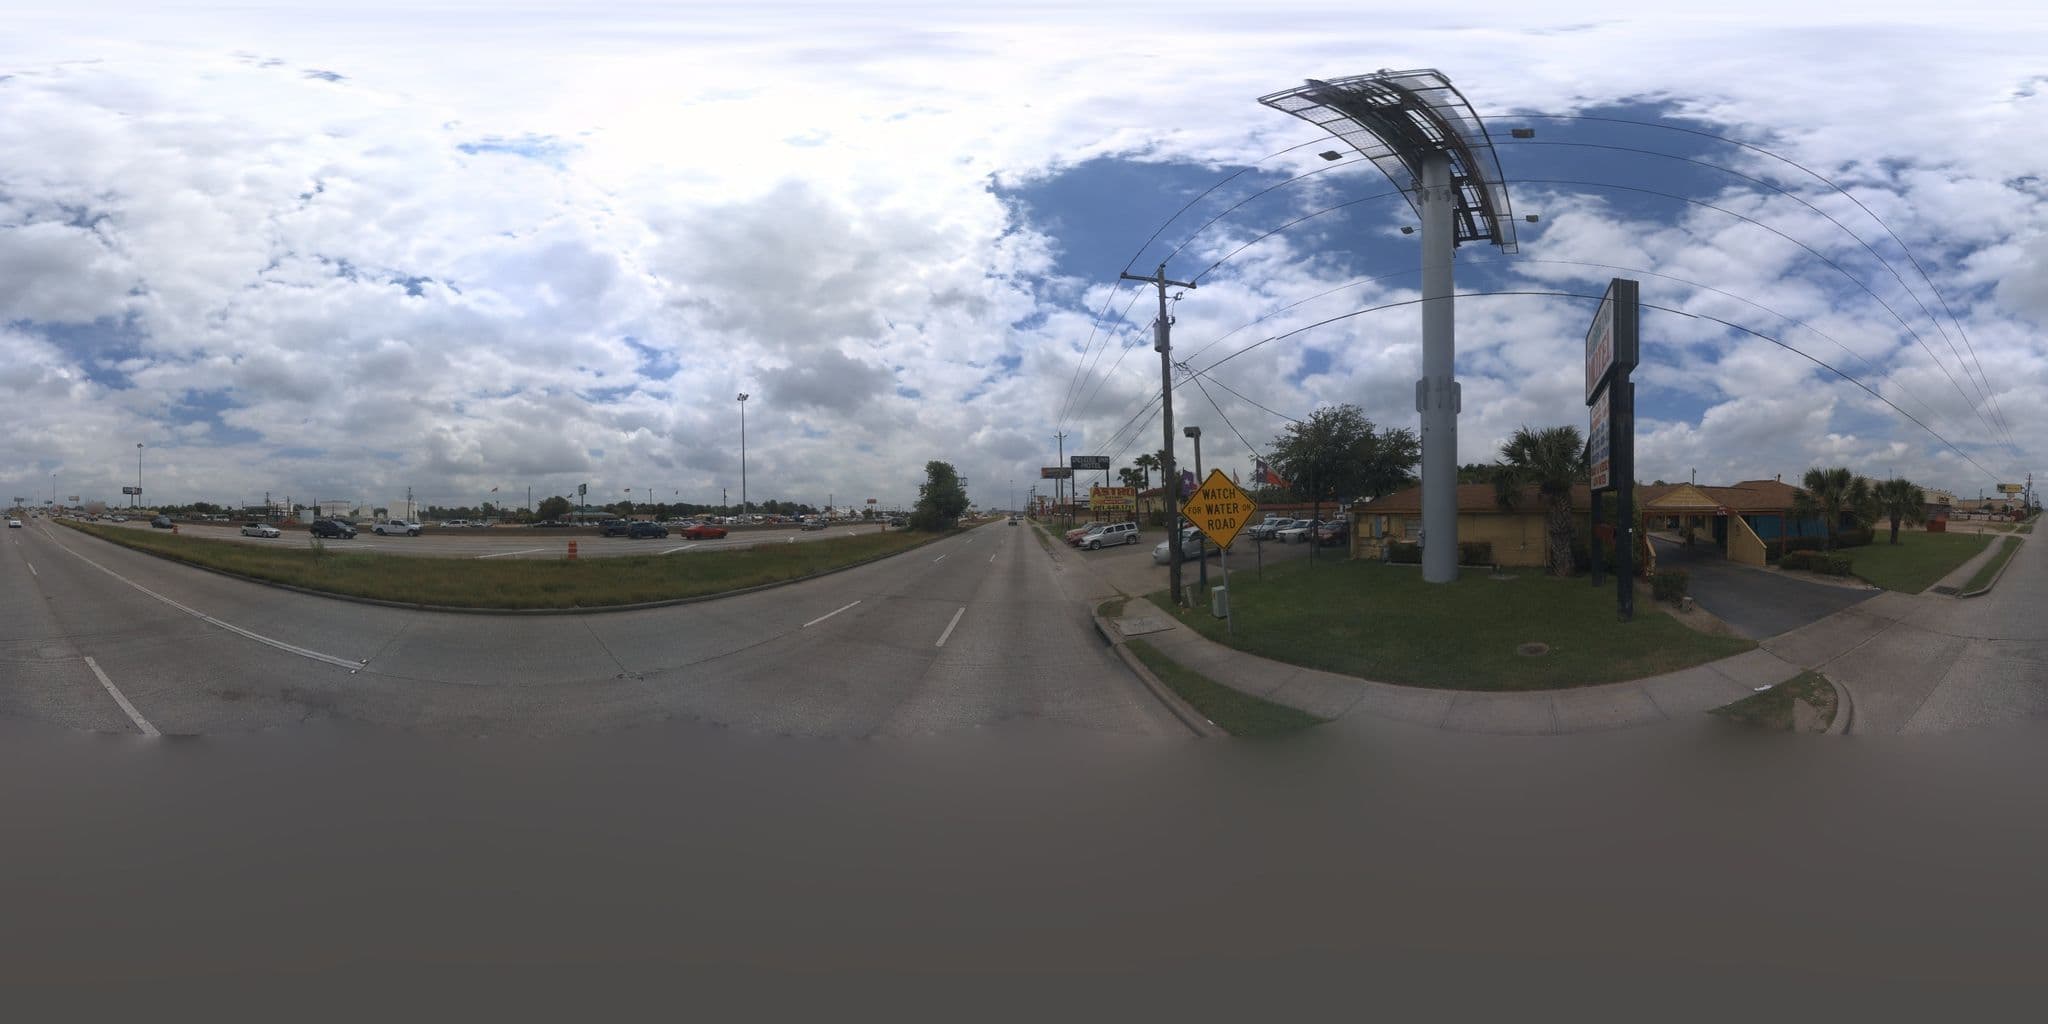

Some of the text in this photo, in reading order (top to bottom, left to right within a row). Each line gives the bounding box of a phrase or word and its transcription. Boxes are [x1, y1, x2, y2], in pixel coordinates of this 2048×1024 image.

[1202, 488, 1236, 500] WATCH
[1188, 503, 1251, 515] FOR WATER ON
[1207, 517, 1236, 530] ROAD
